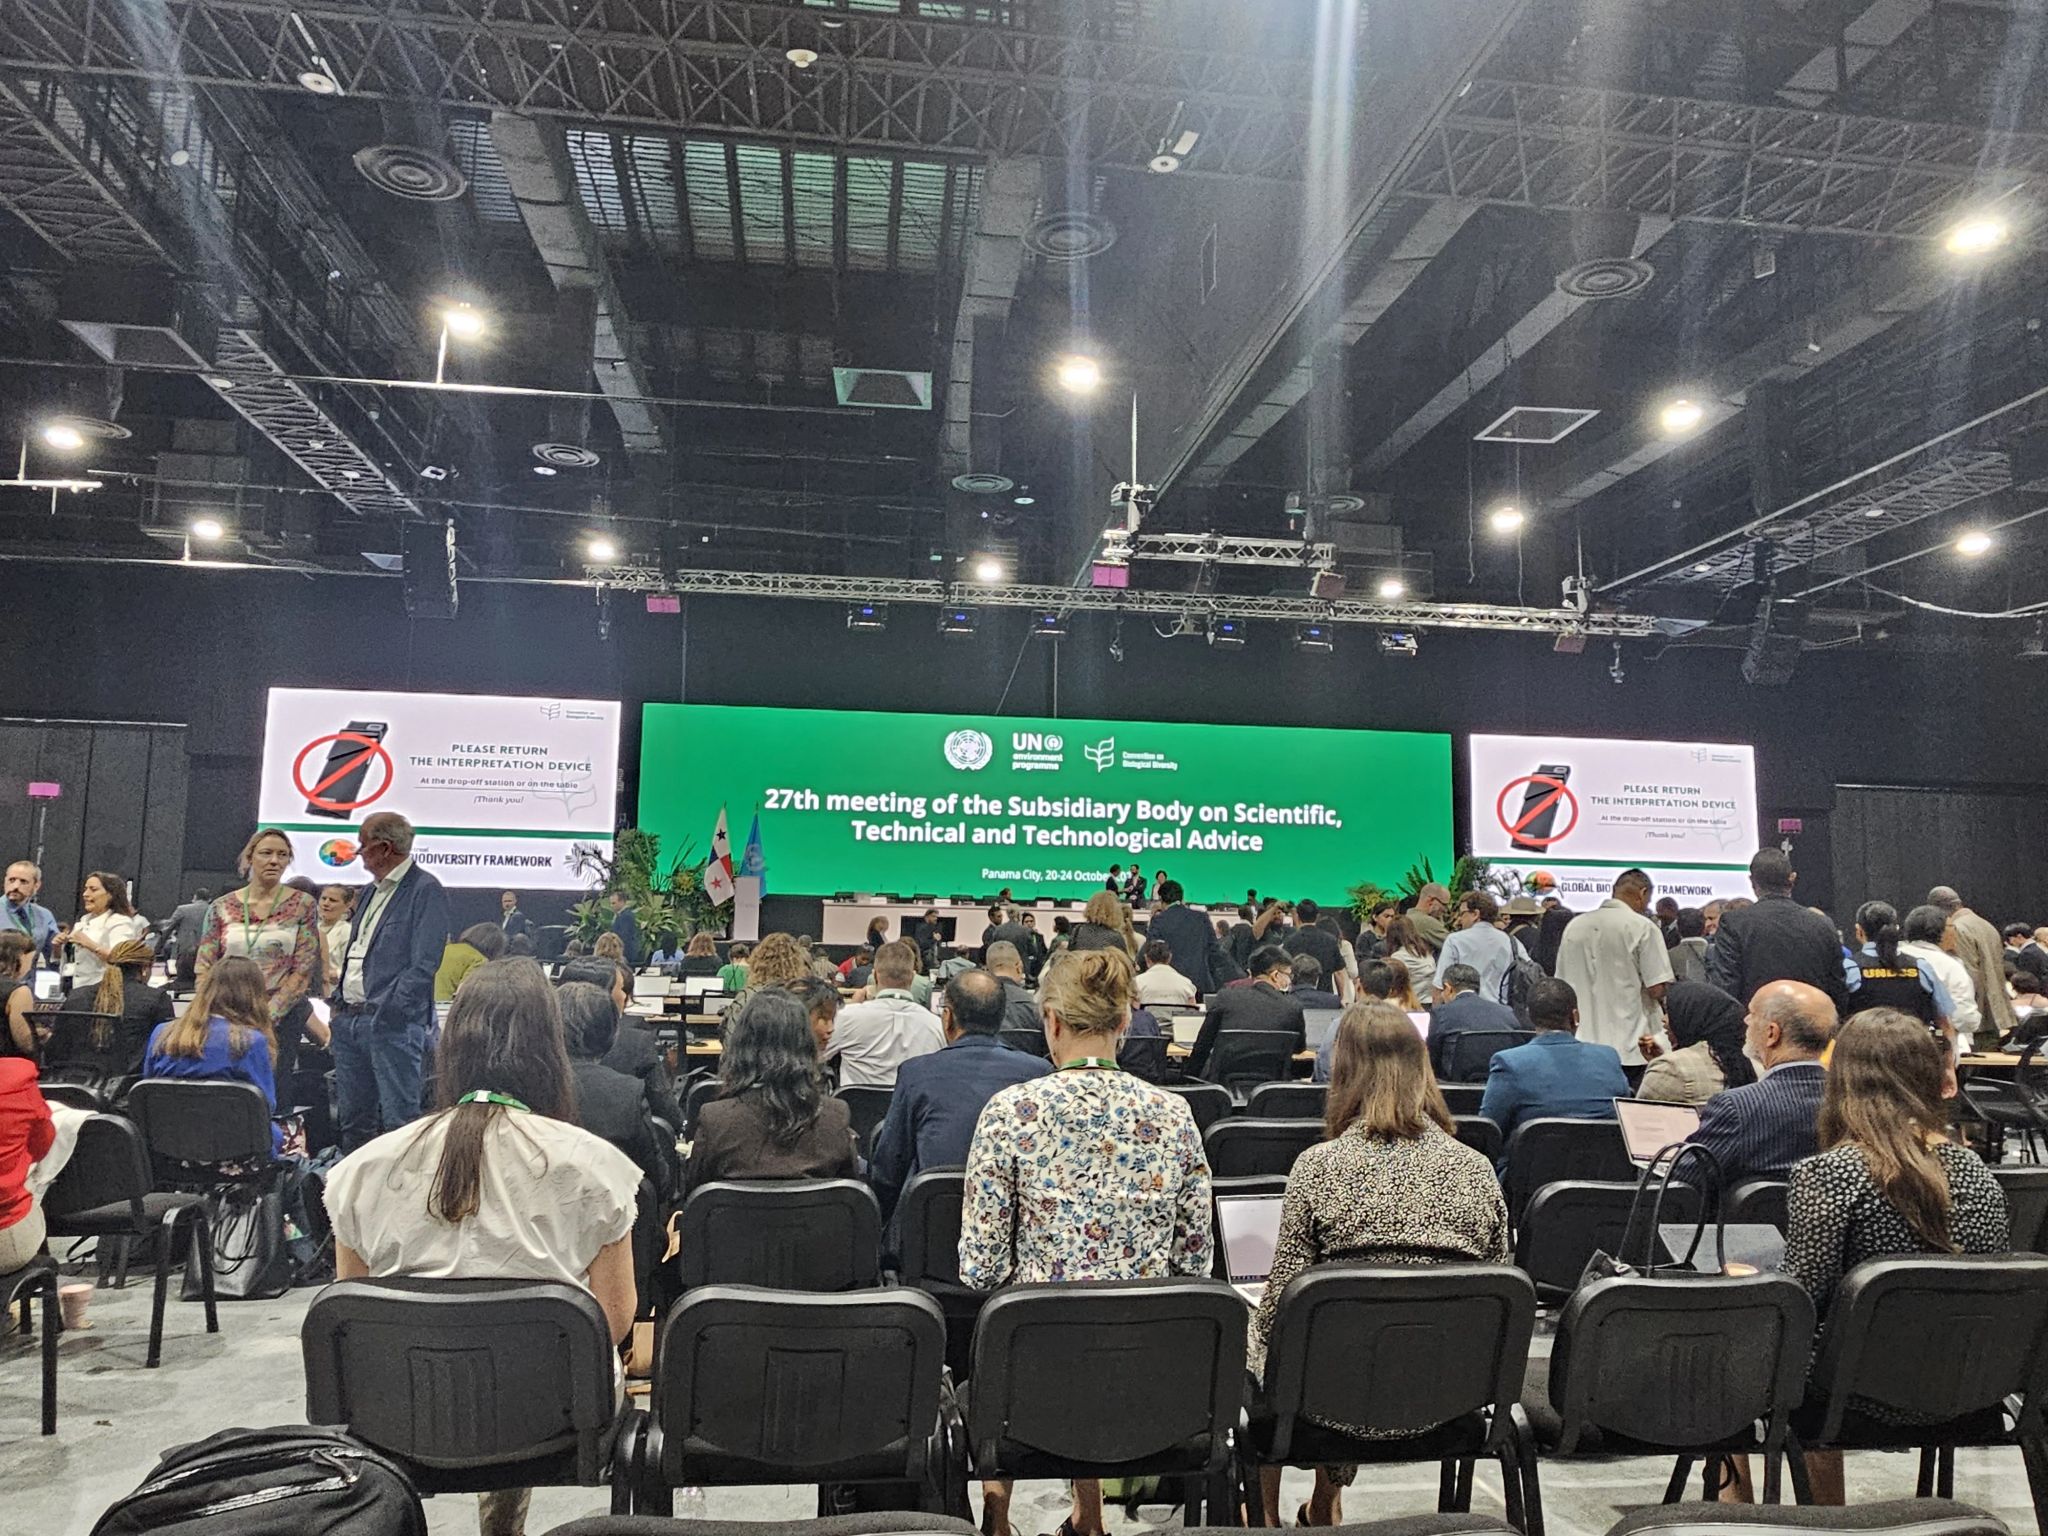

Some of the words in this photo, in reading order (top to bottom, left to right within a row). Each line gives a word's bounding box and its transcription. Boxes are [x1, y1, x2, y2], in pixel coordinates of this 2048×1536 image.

[1012, 733, 1042, 750] UN
[452, 744, 496, 754] PLEASE
[500, 745, 548, 756] RETURN
[1122, 751, 1155, 760] Convention
[1012, 753, 1063, 762] environment
[410, 757, 433, 766] THE
[437, 757, 544, 770] INTERPRETATION
[548, 762, 592, 772] DEVICE
[1012, 762, 1059, 771] programme
[1122, 759, 1151, 769] Biological
[1152, 760, 1178, 770] Diversity
[420, 777, 429, 785] At
[431, 777, 445, 785] the
[448, 778, 483, 787] drop-off
[484, 779, 514, 787] station
[540, 780, 554, 788] the
[556, 781, 578, 789] table
[1623, 784, 1658, 794] PLEASE
[1662, 785, 1701, 795] RETURN
[505, 796, 524, 805] you!
[1590, 796, 1610, 805] THE
[1612, 797, 1698, 808] INTERPRETATION
[1701, 800, 1736, 809] DEVICE
[764, 788, 819, 810] 27th
[827, 791, 927, 818] meeting
[932, 793, 958, 814] of
[962, 794, 1002, 815] the
[1008, 796, 1131, 824] Subsidiary
[1136, 800, 1194, 826] Body
[1199, 805, 1228, 822] on
[1234, 803, 1342, 828] Scientific,
[1622, 815, 1650, 823] drop-off
[852, 820, 965, 843] Technical
[971, 824, 1016, 844] and
[1022, 824, 1181, 853] Technological
[1187, 829, 1263, 851] Advice
[484, 855, 552, 867] FRAMEWORK
[982, 868, 1020, 879] Panama
[1022, 868, 1043, 882] City,
[1045, 869, 1072, 881] 20-24
[1074, 870, 1110, 882] Octobe
[1561, 882, 1594, 892] GLOBAL
[1658, 885, 1713, 896] FRAMEWORK
